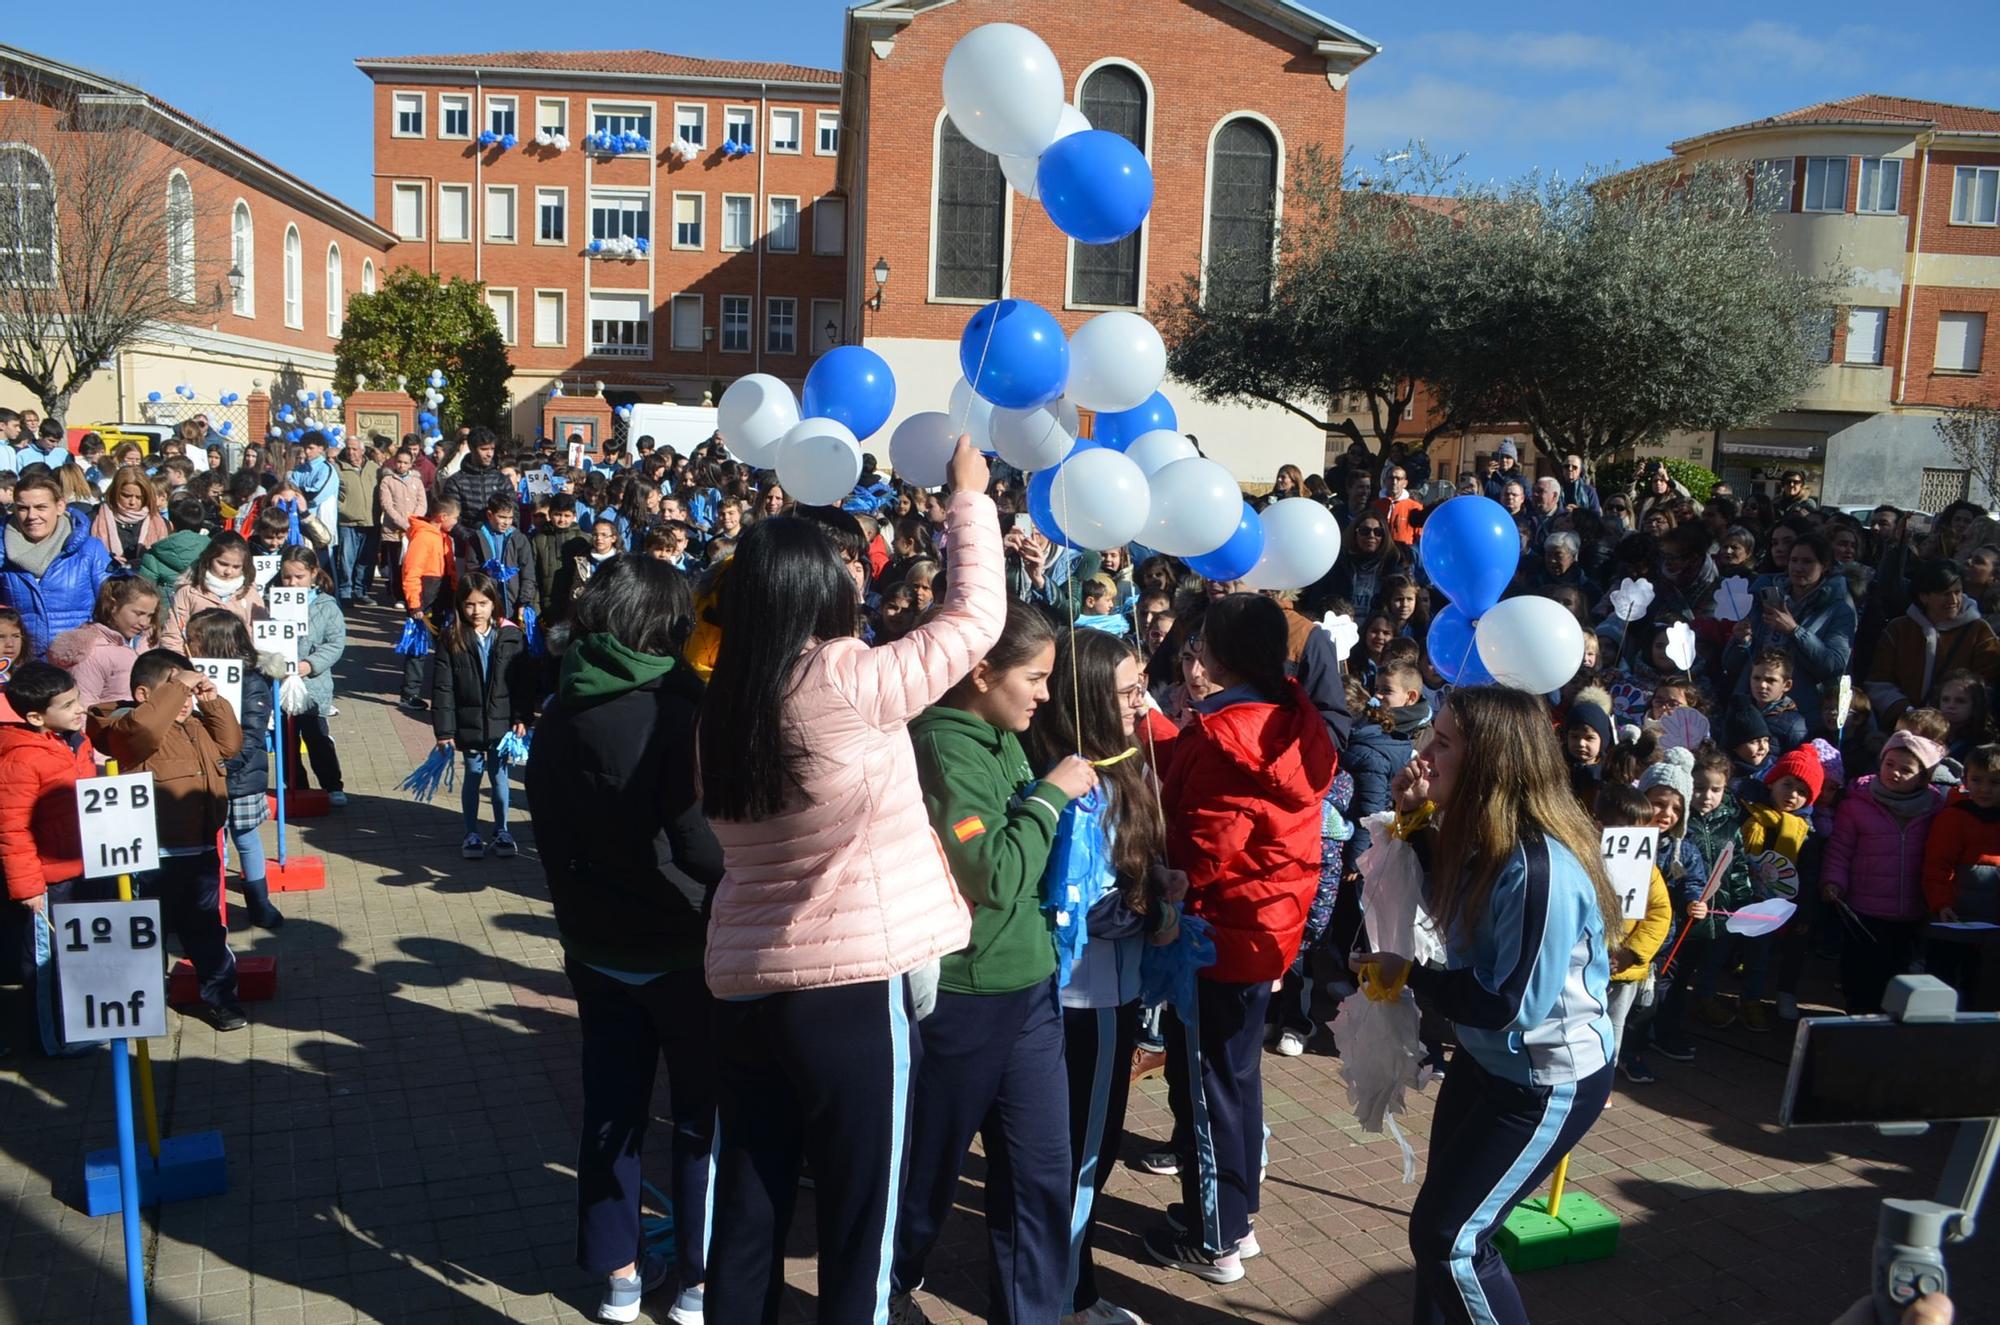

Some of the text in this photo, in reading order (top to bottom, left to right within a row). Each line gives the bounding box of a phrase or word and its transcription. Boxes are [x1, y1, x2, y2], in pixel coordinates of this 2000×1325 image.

[257, 561, 271, 571] 3º
[274, 592, 305, 604] 2º B
[258, 624, 277, 639] 1º
[284, 625, 294, 639] B
[227, 666, 240, 684] B
[84, 784, 150, 814] 2º B
[101, 837, 142, 867] Inf
[1603, 835, 1652, 860] 1º A
[64, 916, 156, 952] 1º B
[85, 990, 145, 1028] Inf
